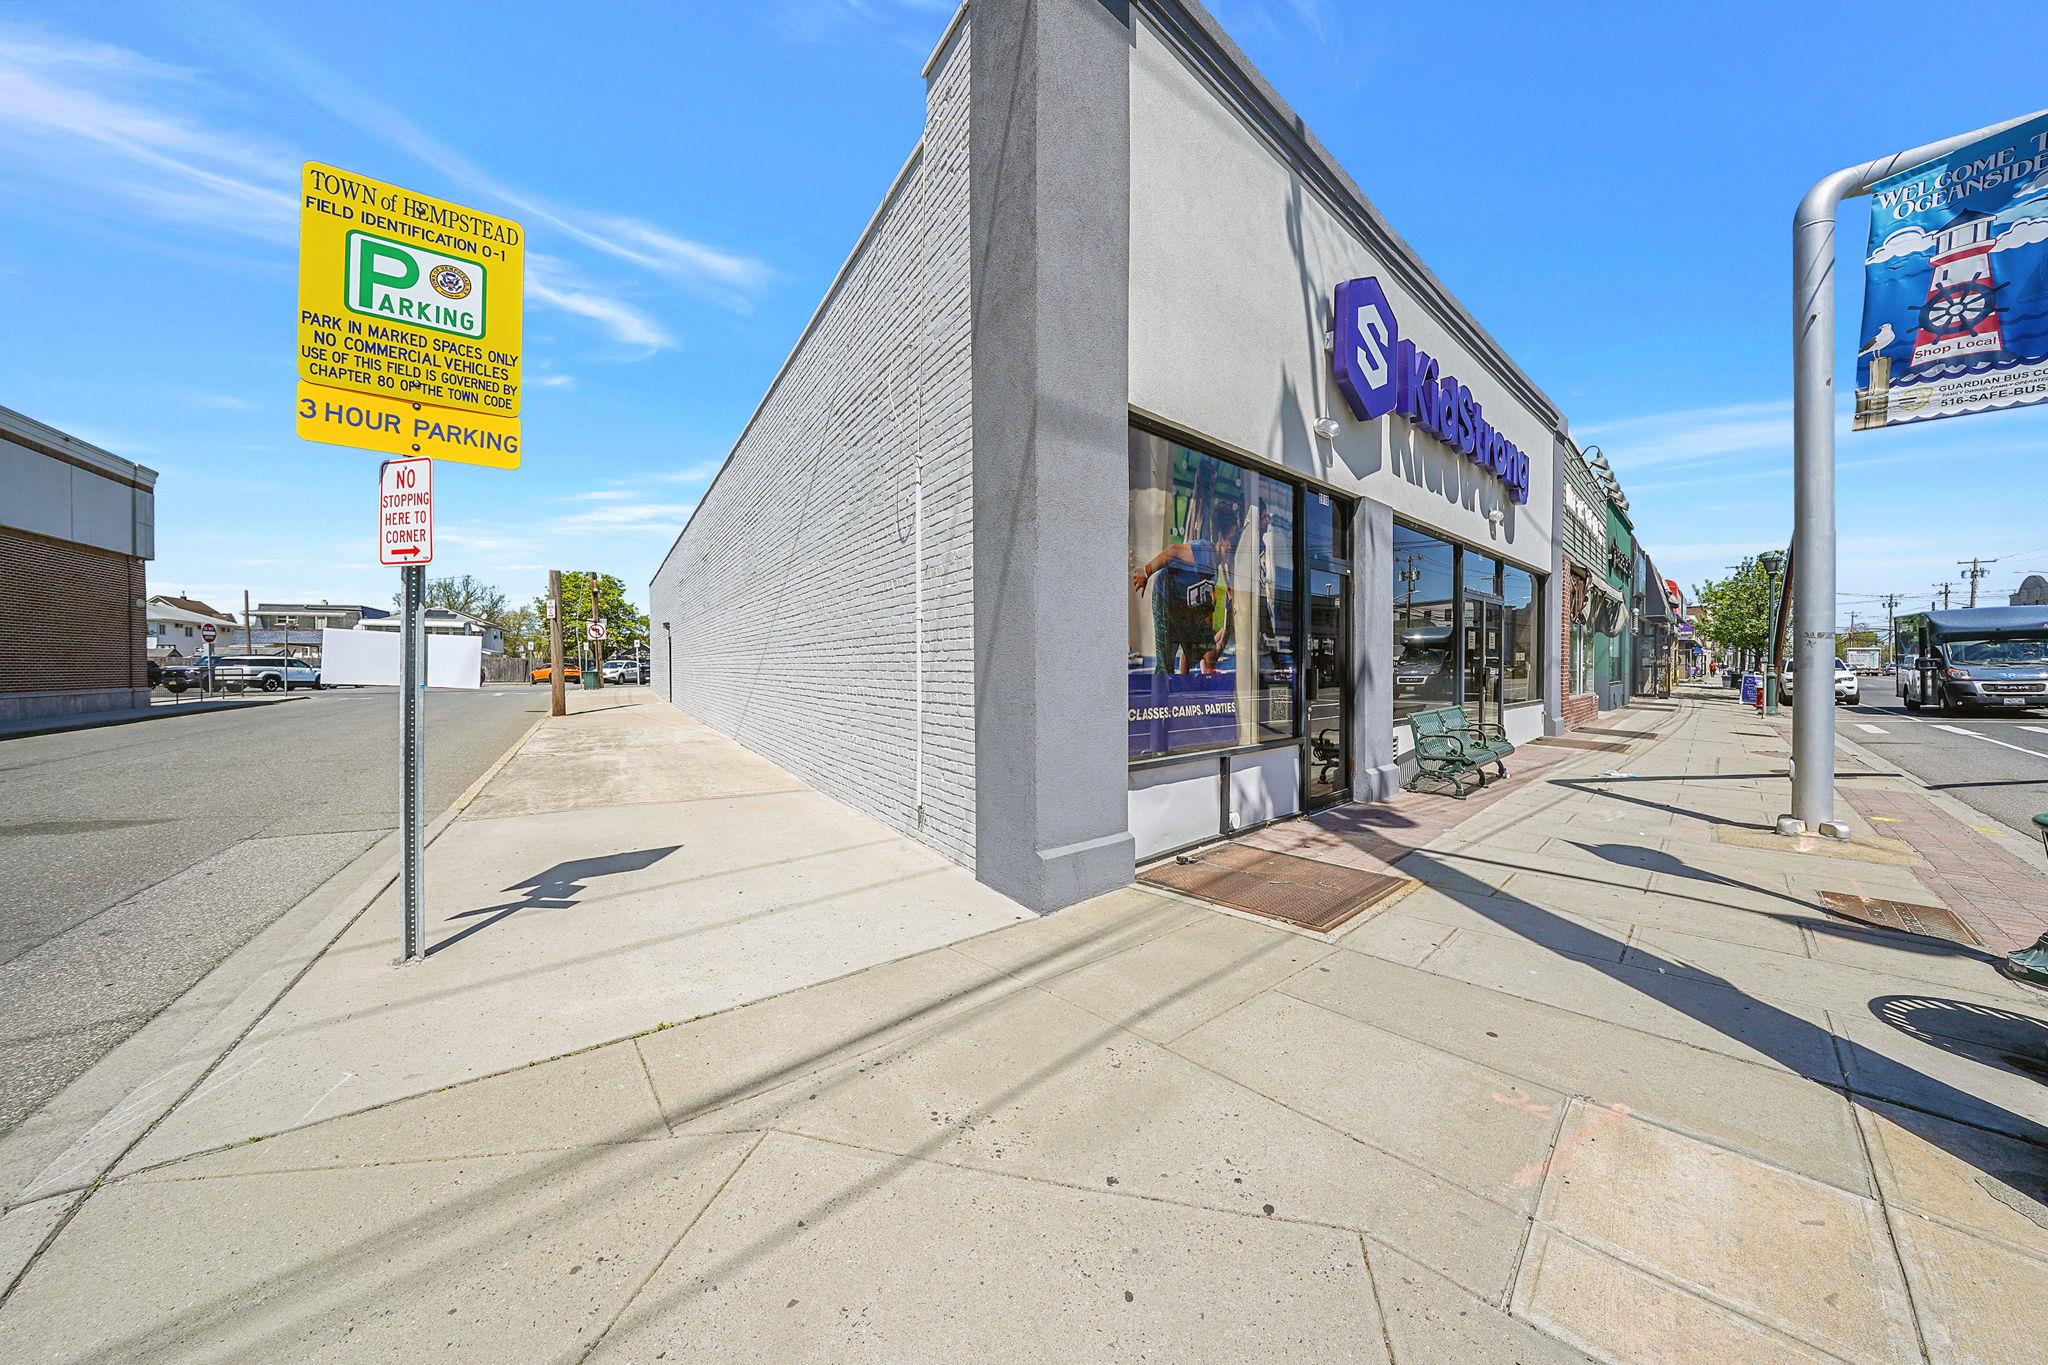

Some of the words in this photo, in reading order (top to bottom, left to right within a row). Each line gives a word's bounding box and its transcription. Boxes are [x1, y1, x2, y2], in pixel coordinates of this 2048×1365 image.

[1874, 147, 2015, 209] WELCOME
[1893, 153, 2048, 220] OCEANSIDE
[306, 196, 353, 219] FIELD
[361, 211, 477, 254] IDENTIFICATION
[311, 170, 377, 206] TOWN
[381, 195, 397, 212] of
[403, 197, 519, 246] HEMPSTEAD
[359, 238, 474, 331] PARKING
[301, 310, 342, 331] PARK
[348, 320, 362, 335] IN
[368, 325, 427, 348] MARKED
[433, 339, 482, 360] SPACES
[488, 351, 518, 367] ONLY
[314, 330, 336, 347] NO
[344, 336, 441, 368] COMMERCIAL
[444, 357, 509, 381] VEHICLES
[1915, 345, 1951, 360] Shop
[1957, 336, 1997, 349] Local
[301, 345, 327, 361] USE
[332, 351, 348, 364] OF
[354, 355, 382, 371] THIS
[387, 362, 421, 378] FIELD
[426, 369, 436, 381] IS
[441, 372, 500, 393] GOVERNED
[503, 384, 518, 396] BY
[309, 362, 371, 385] CHAPTER
[378, 375, 395, 389] 80
[421, 383, 443, 397] THE
[448, 387, 479, 404] TOWN
[484, 395, 512, 410] CODE
[1939, 377, 2000, 392] GUARDIAN
[2004, 372, 2029, 381] BUS
[299, 398, 317, 419] 3
[325, 402, 401, 435] HOUR
[414, 419, 518, 453] PARKING
[1397, 339, 1530, 505] KidStrong
[382, 492, 429, 509] STOPPING
[396, 469, 416, 489] NO
[385, 512, 411, 526] HERE
[414, 510, 427, 524] TO
[386, 529, 426, 544] CORNER
[1205, 702, 1236, 715] PARTIES
